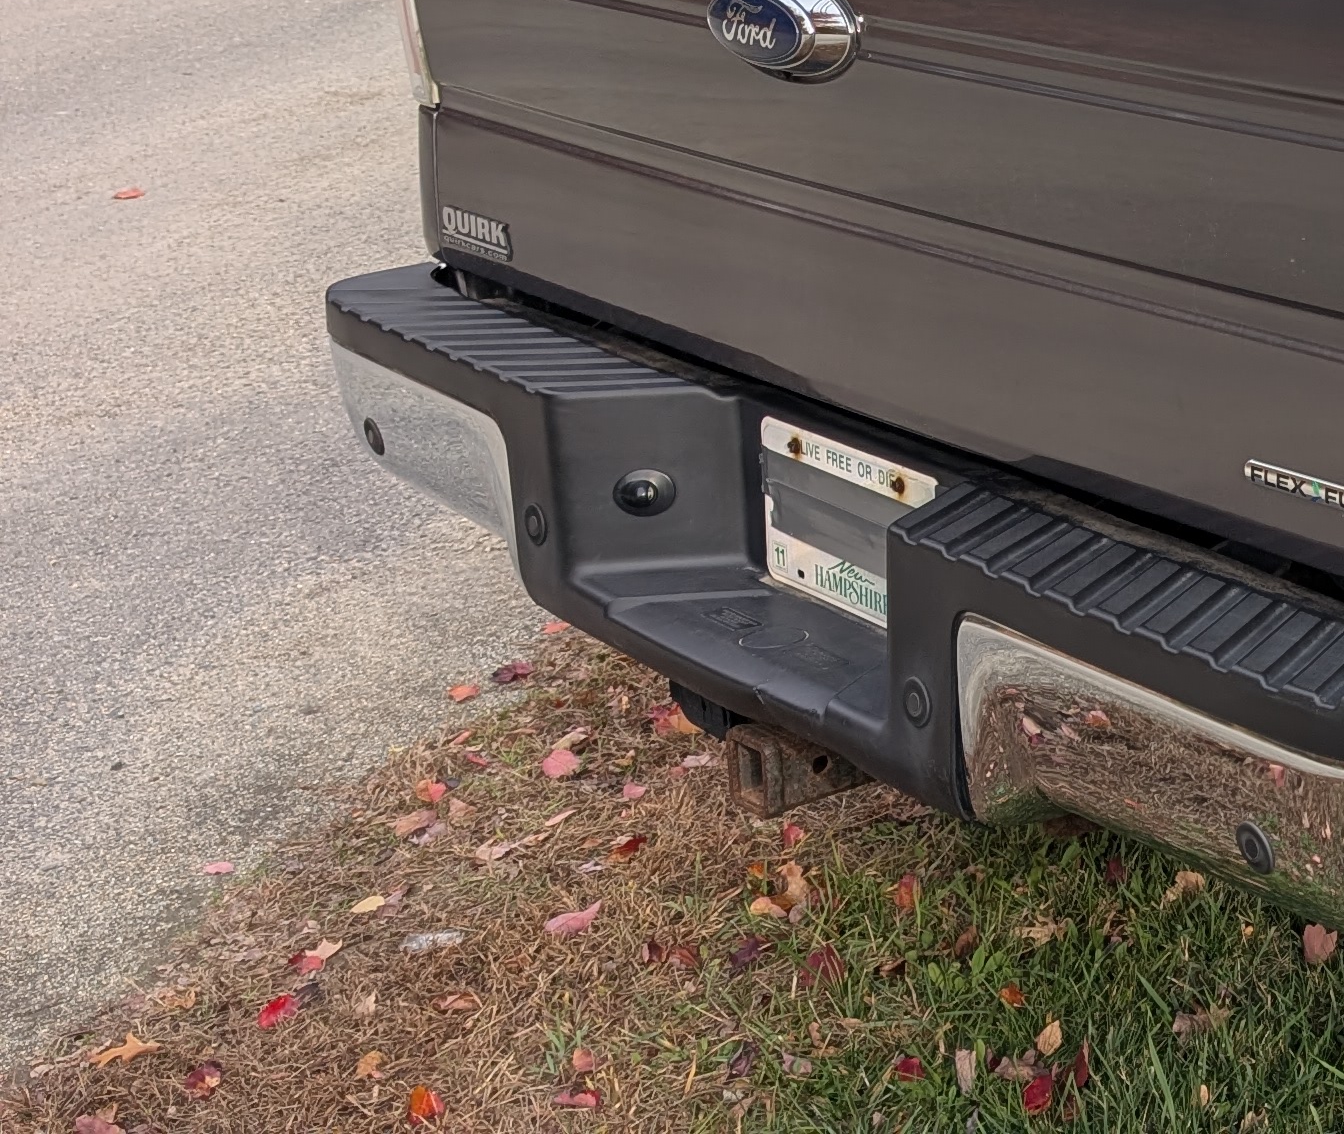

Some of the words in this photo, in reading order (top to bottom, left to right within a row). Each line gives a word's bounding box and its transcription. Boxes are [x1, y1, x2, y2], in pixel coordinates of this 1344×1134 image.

[442, 206, 507, 247] QUIRK
[801, 439, 821, 462] LIVE
[826, 449, 852, 473] FREE
[857, 461, 873, 481] OR
[1250, 465, 1307, 497] FLEX
[774, 546, 786, 567] 11
[829, 558, 875, 586] New
